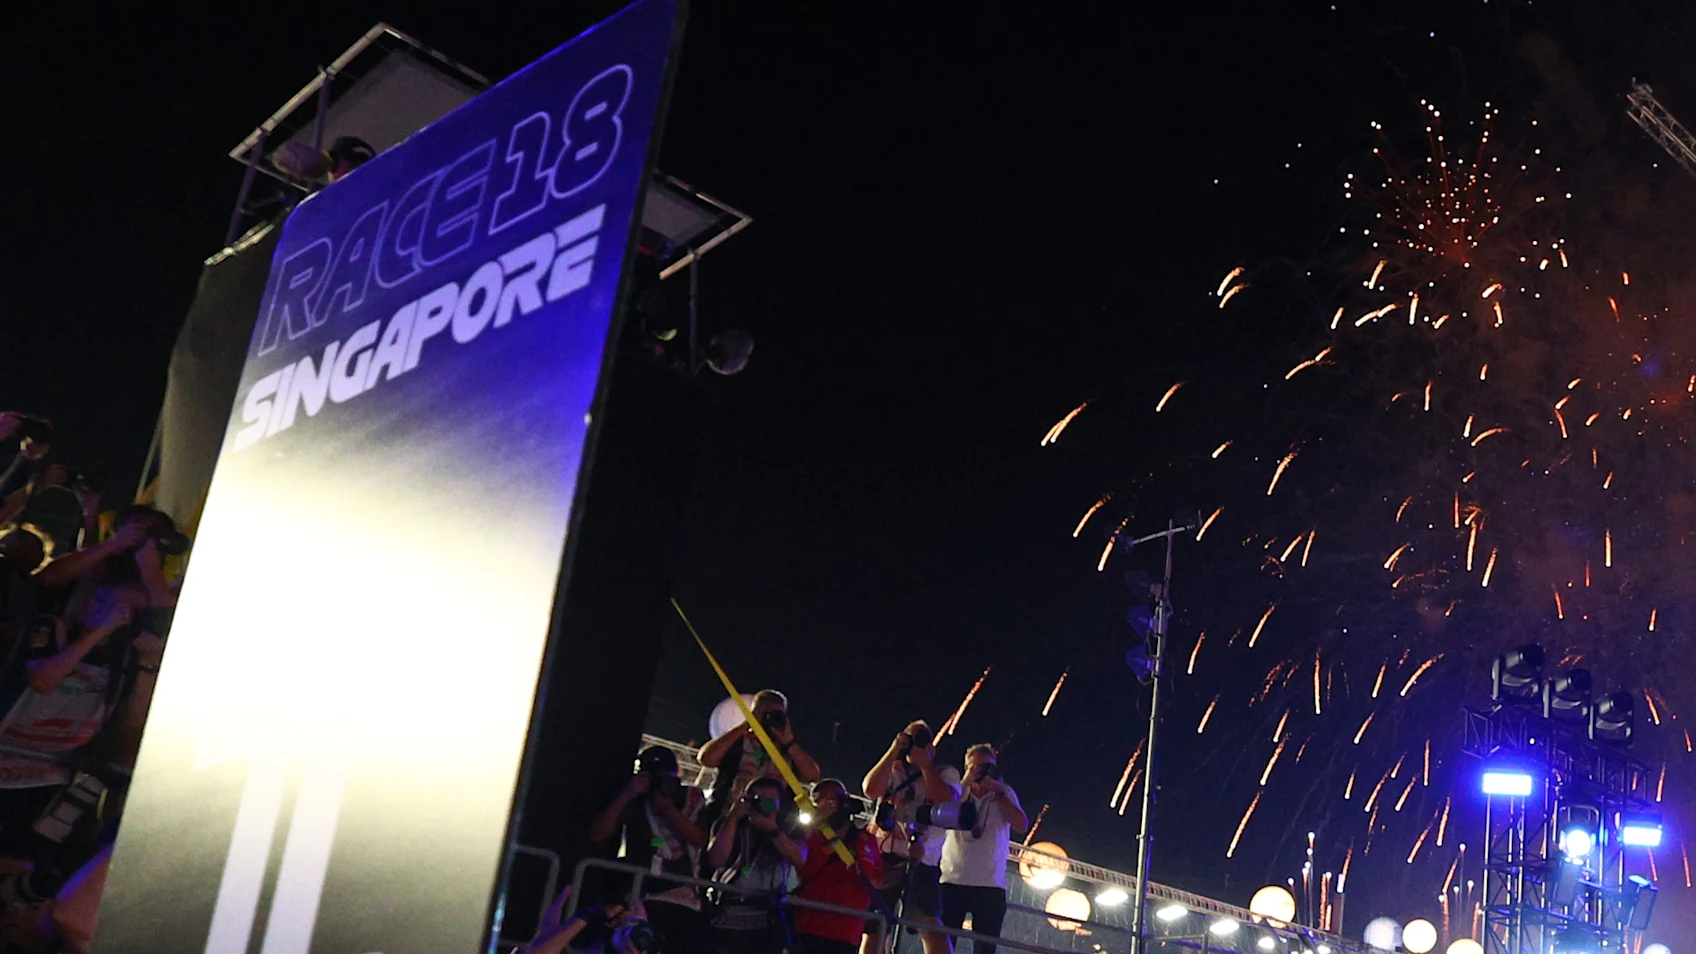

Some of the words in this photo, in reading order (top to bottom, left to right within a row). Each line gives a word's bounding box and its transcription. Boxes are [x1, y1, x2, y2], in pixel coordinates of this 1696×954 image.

[232, 204, 606, 452] SINGAPORE
[257, 139, 497, 358] RACE
[488, 63, 633, 237] 18
